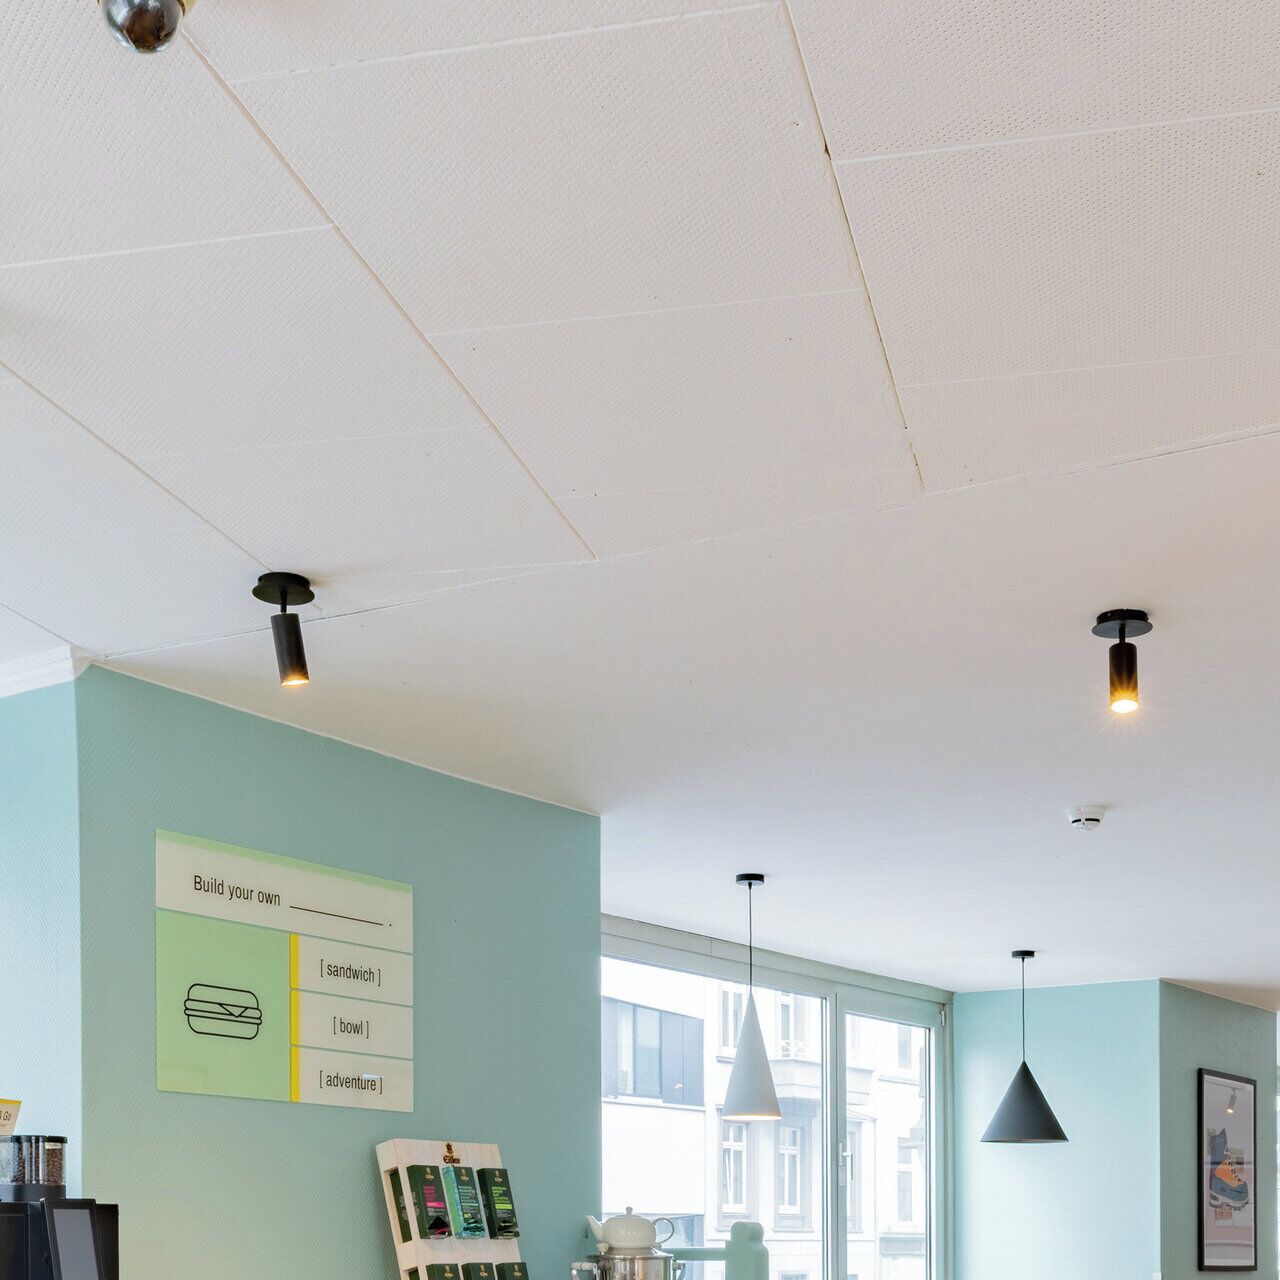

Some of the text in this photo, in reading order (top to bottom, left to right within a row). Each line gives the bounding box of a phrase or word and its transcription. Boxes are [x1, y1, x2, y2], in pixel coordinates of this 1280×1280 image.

[193, 874, 281, 906] Build your own
[326, 964, 375, 983] sandwich
[340, 1017, 363, 1035] bowl
[326, 1073, 377, 1091] adventure
